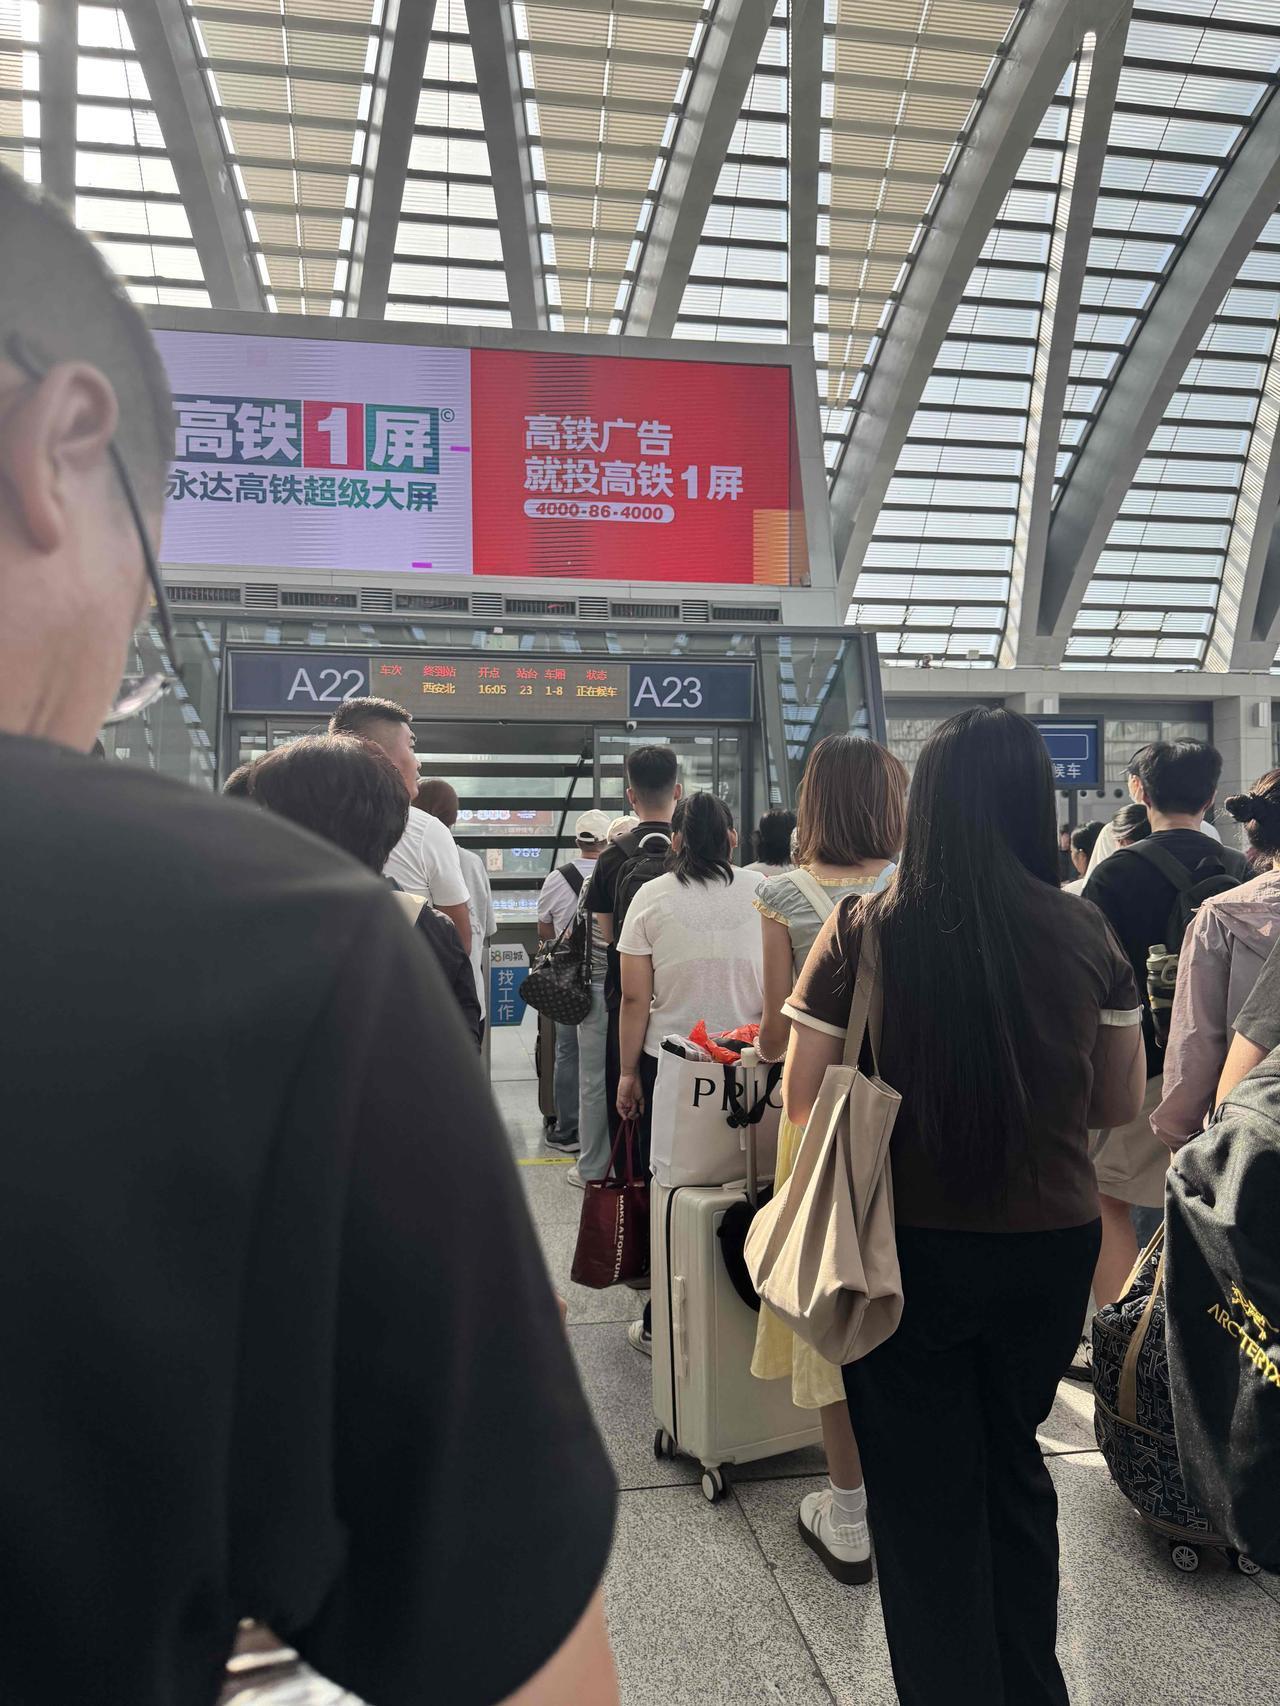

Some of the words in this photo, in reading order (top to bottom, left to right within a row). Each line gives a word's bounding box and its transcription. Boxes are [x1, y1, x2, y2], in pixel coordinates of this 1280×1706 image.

[524, 414, 673, 456] 高铁广告
[165, 469, 438, 512] 永达高铁超级大屏
[524, 456, 743, 501] 就投高铁1屏
[535, 502, 664, 520] 4000-86-4000
[287, 667, 365, 702] A22
[379, 665, 402, 676] 车次
[478, 666, 500, 678] 开点
[515, 668, 538, 679] 站台
[544, 668, 566, 680] 车厢
[586, 669, 607, 680] 状态
[422, 682, 456, 694] 西安北
[479, 684, 507, 695] 16:05
[519, 685, 533, 695] 23
[545, 686, 564, 696] 1-8
[576, 686, 618, 697] 正在候车
[633, 676, 703, 708] A23
[498, 970, 514, 1022] 找工作
